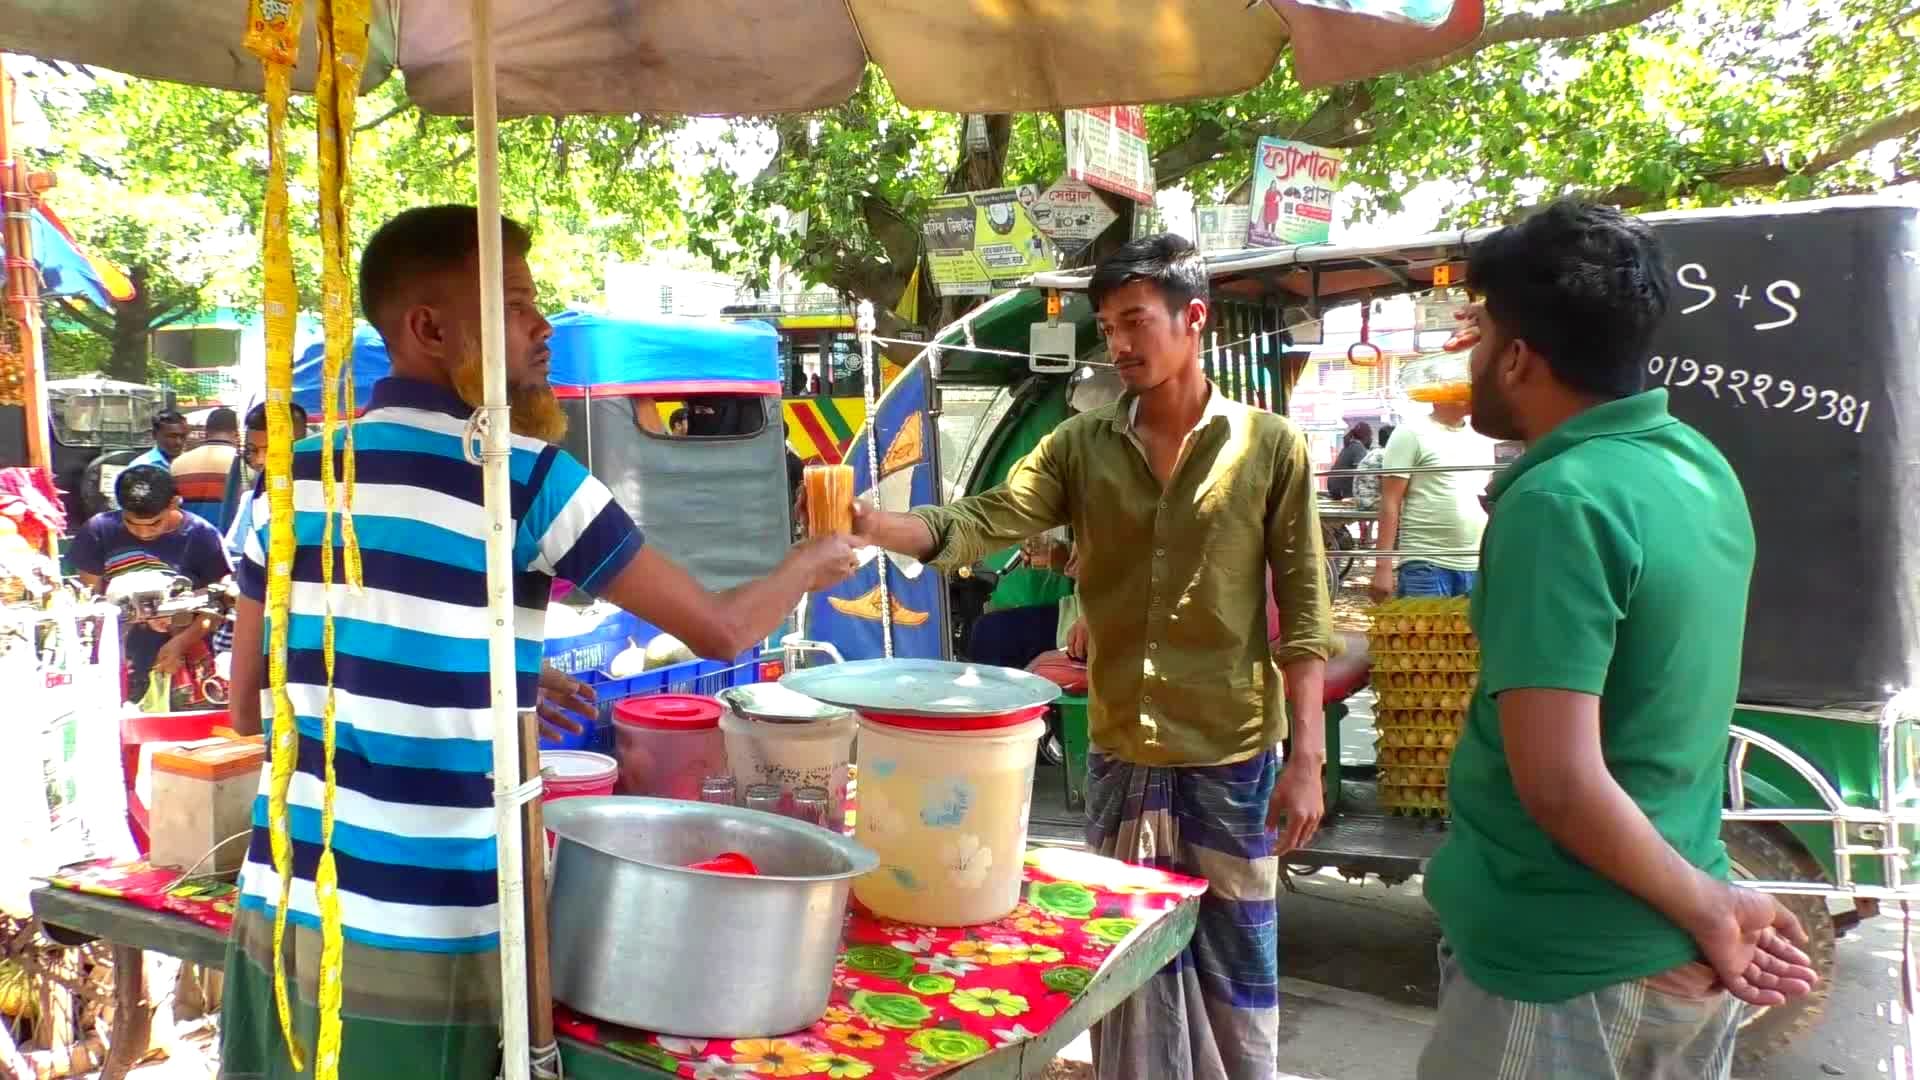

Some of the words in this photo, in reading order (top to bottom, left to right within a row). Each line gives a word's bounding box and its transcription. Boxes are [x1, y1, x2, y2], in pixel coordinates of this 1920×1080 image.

[1302, 185, 1332, 206] প্লাস
[1676, 263, 1717, 314] S
[1733, 284, 1752, 309] +
[1753, 279, 1801, 331] S
